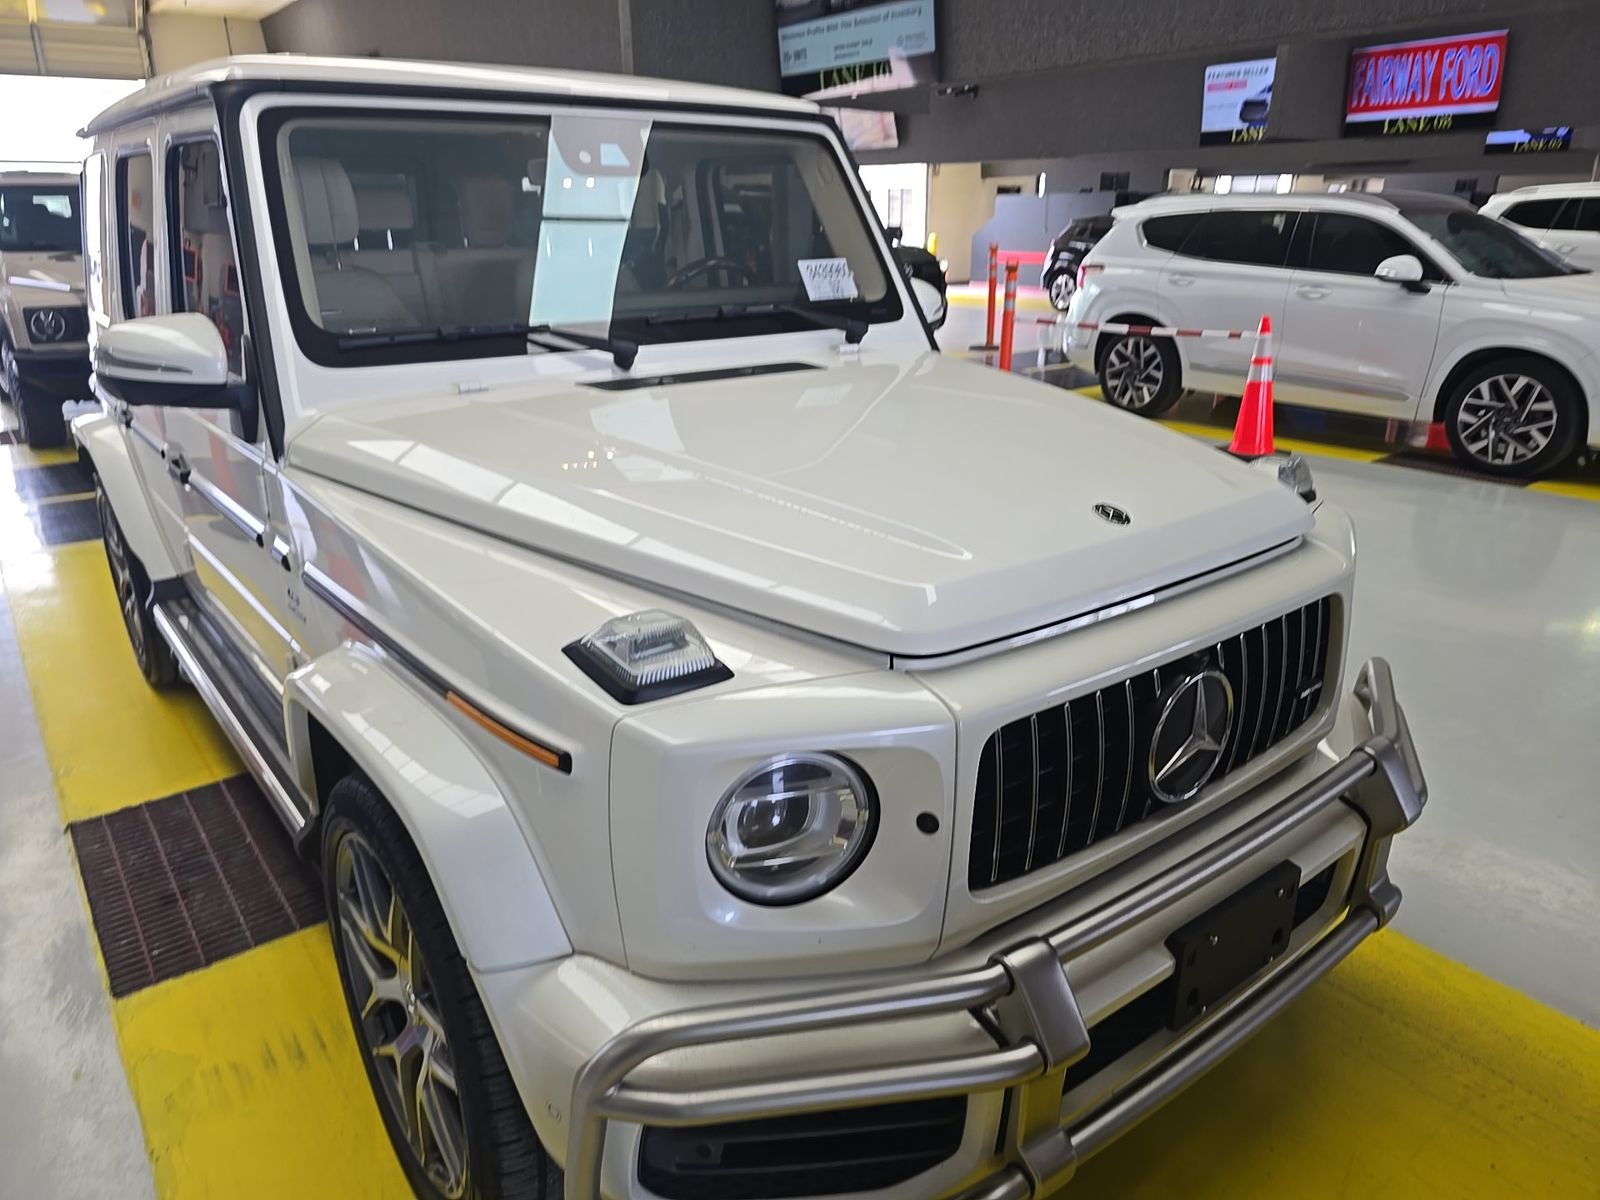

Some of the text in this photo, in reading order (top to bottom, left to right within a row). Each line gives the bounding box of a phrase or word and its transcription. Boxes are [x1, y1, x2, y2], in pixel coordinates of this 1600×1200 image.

[1351, 43, 1500, 108] FAIRWAY FORD
[1382, 114, 1432, 135] LANE
